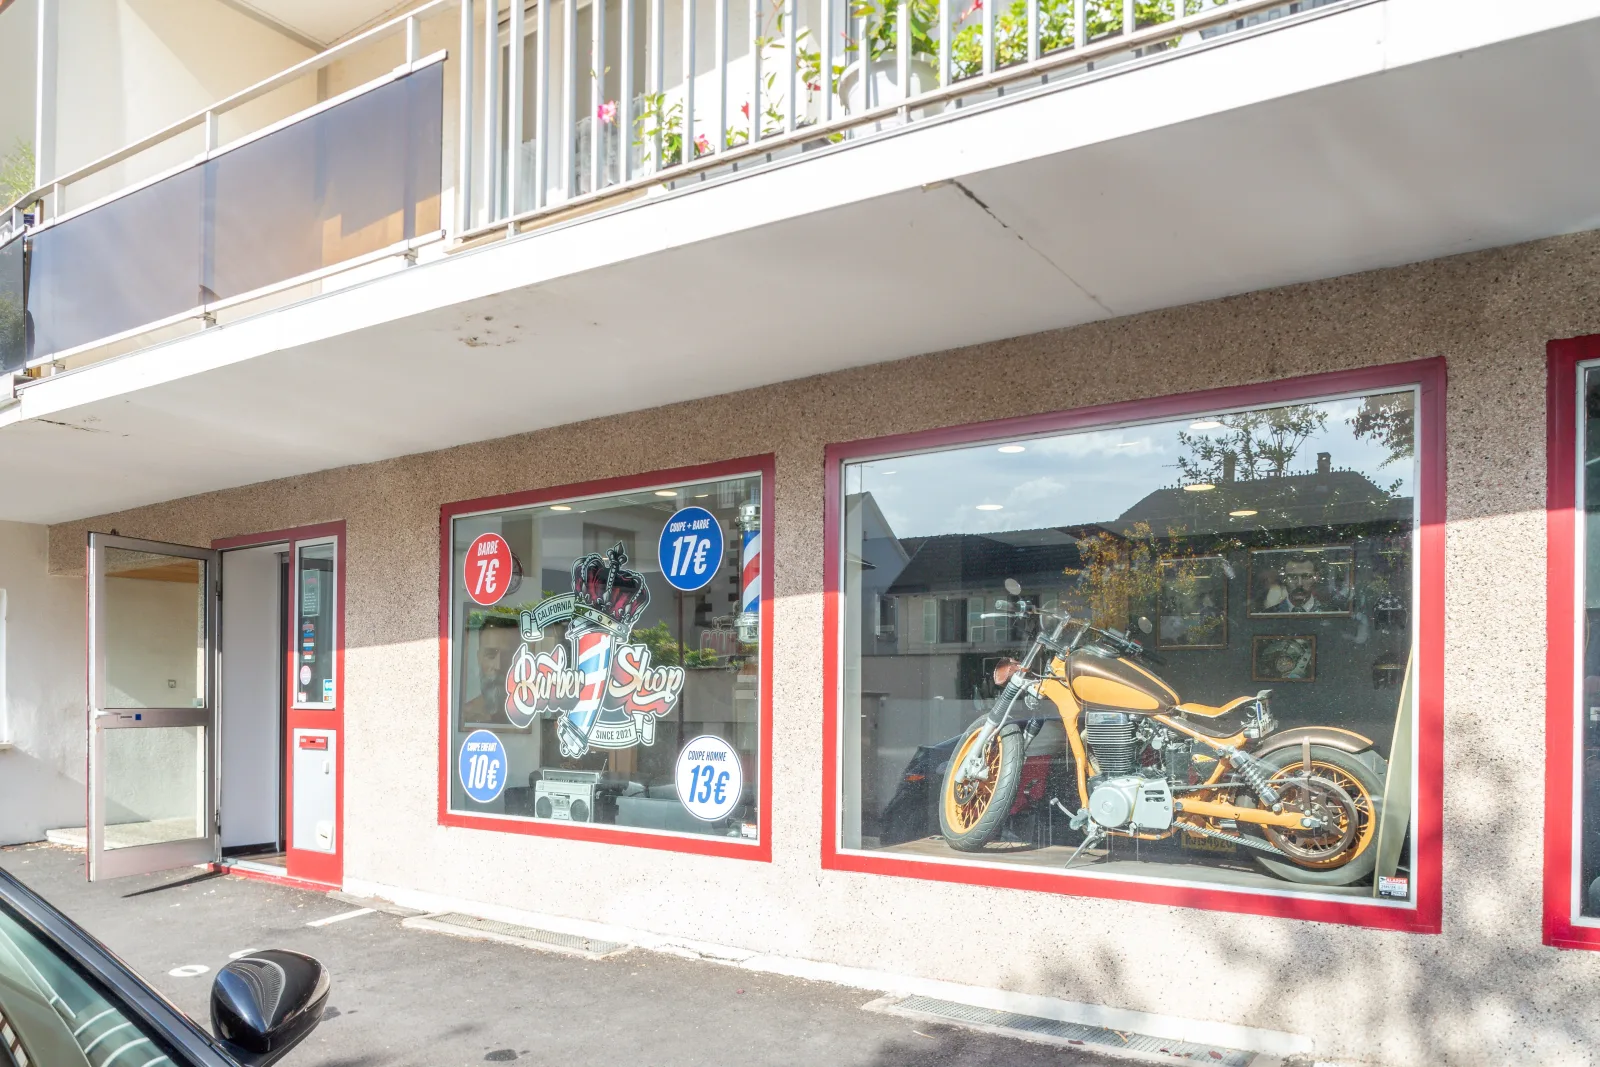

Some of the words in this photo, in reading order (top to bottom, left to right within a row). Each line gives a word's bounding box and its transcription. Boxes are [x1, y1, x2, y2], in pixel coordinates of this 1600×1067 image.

[669, 521, 686, 533] COUPE
[692, 518, 711, 531] BARBE
[477, 540, 500, 557] BARBE
[670, 534, 711, 577] 17€
[474, 558, 500, 595] 7€
[537, 600, 573, 620] CALIFORNIA
[512, 644, 586, 716] Barber
[608, 645, 684, 706] Shop
[595, 729, 615, 740] SINCE
[616, 728, 632, 739] 2021
[687, 750, 706, 761] COUPE
[706, 751, 727, 762] HOMME
[467, 754, 500, 790] 10€
[688, 764, 731, 805] 13€
